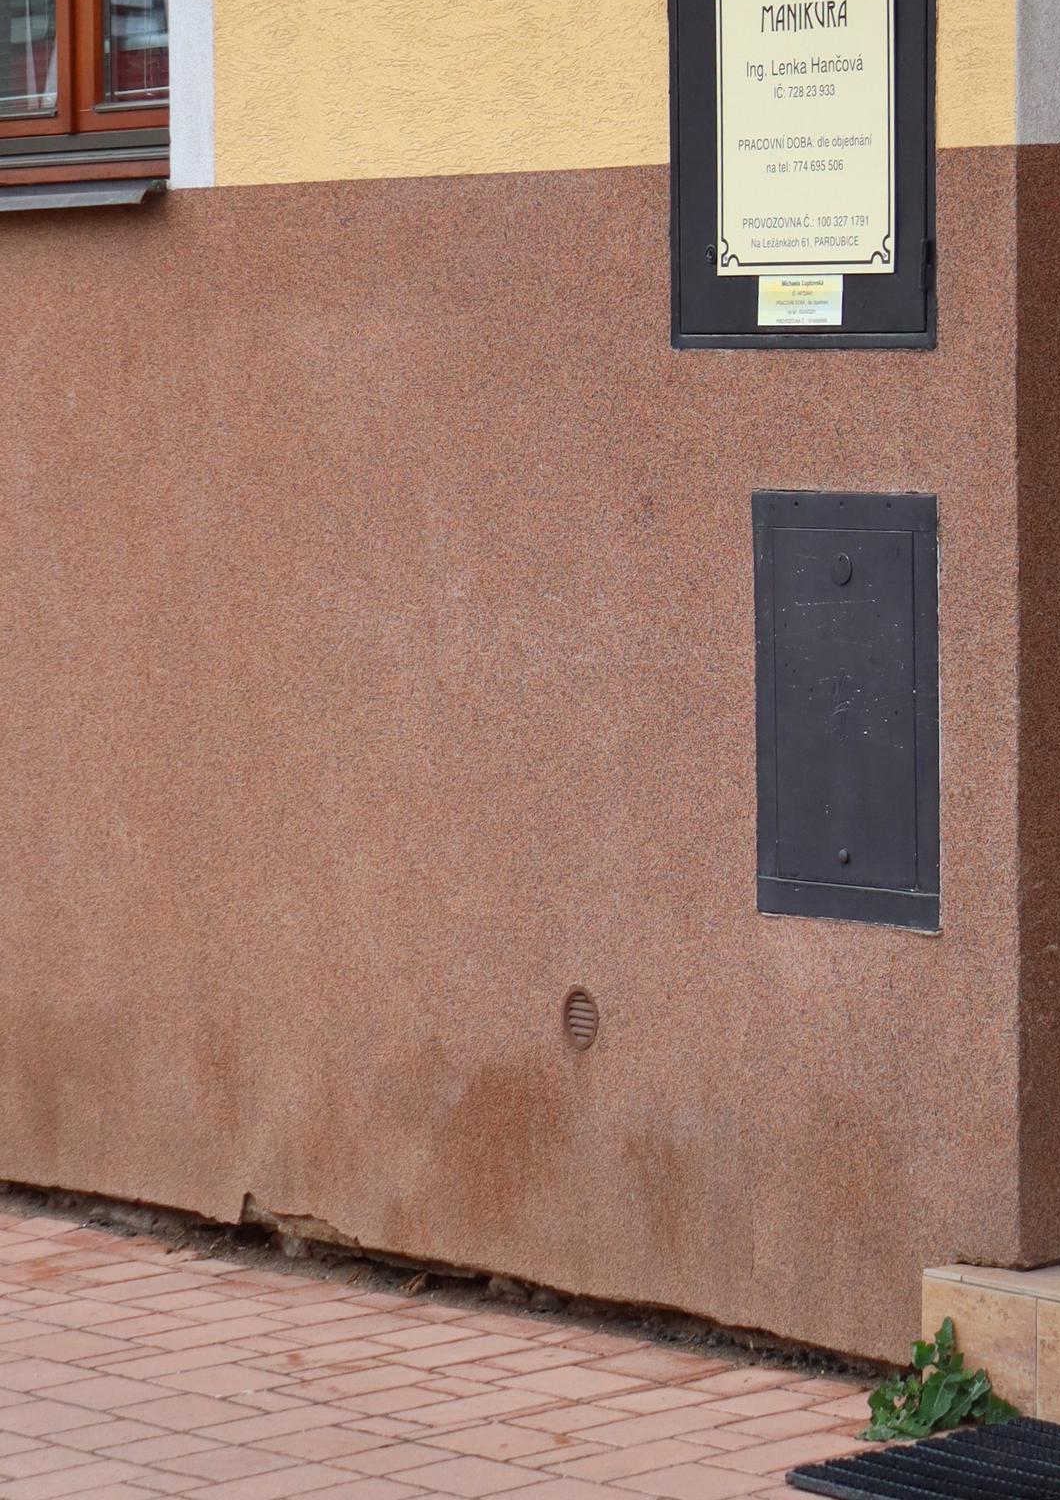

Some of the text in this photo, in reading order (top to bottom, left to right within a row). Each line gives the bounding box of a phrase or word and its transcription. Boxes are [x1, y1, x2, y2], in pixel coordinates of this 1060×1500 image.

[746, 53, 864, 81] Ing. Lenka Hančová
[788, 86, 804, 98] 728
[806, 85, 817, 97] 23
[819, 84, 835, 96] 933
[738, 133, 873, 151] PRACOVNÍ DOBA: dle objednání
[766, 164, 776, 173] na
[793, 160, 808, 172] 774
[810, 159, 826, 172] 695
[828, 158, 844, 171] 506
[742, 216, 801, 229] PROVOZOVNA
[817, 216, 832, 227] 100
[833, 215, 849, 227] 327
[751, 239, 761, 248] Na
[814, 235, 860, 247] PARDUBICE
